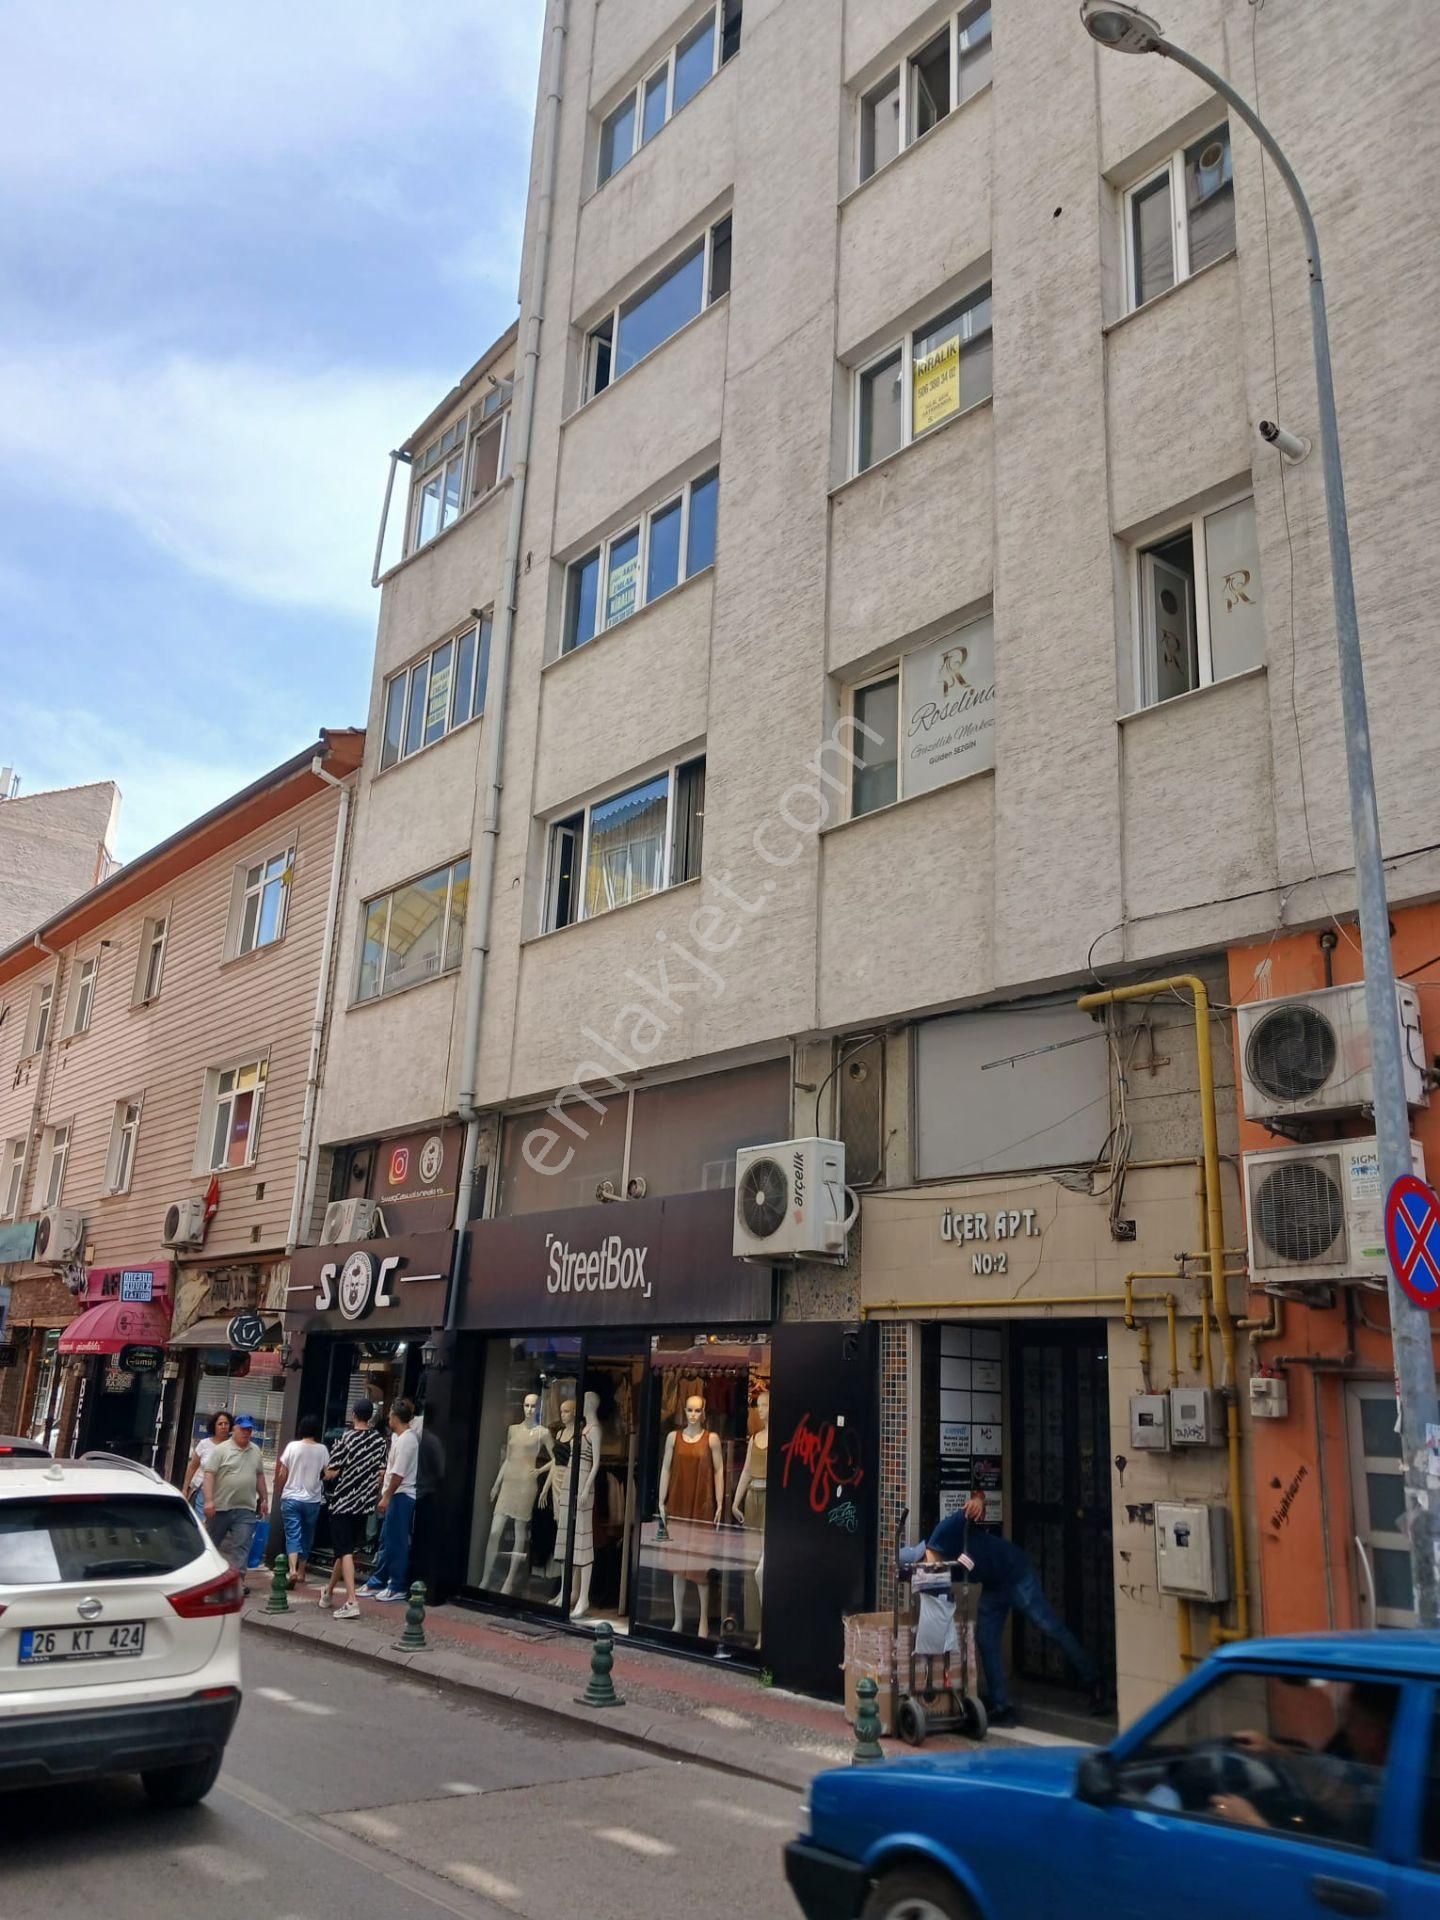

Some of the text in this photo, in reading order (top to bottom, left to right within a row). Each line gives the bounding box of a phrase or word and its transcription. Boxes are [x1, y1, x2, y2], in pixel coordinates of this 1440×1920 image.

[907, 684, 996, 737] Roselina
[793, 1152, 804, 1207] arçelik
[1352, 1153, 1379, 1166] SIGM
[940, 1207, 1040, 1247] ÜÇER APT.
[545, 1234, 651, 1297] StreetBox
[971, 1251, 1008, 1275] NO:2
[151, 1379, 168, 1467] TATT
[33, 1626, 141, 1655] 26 KT 424
